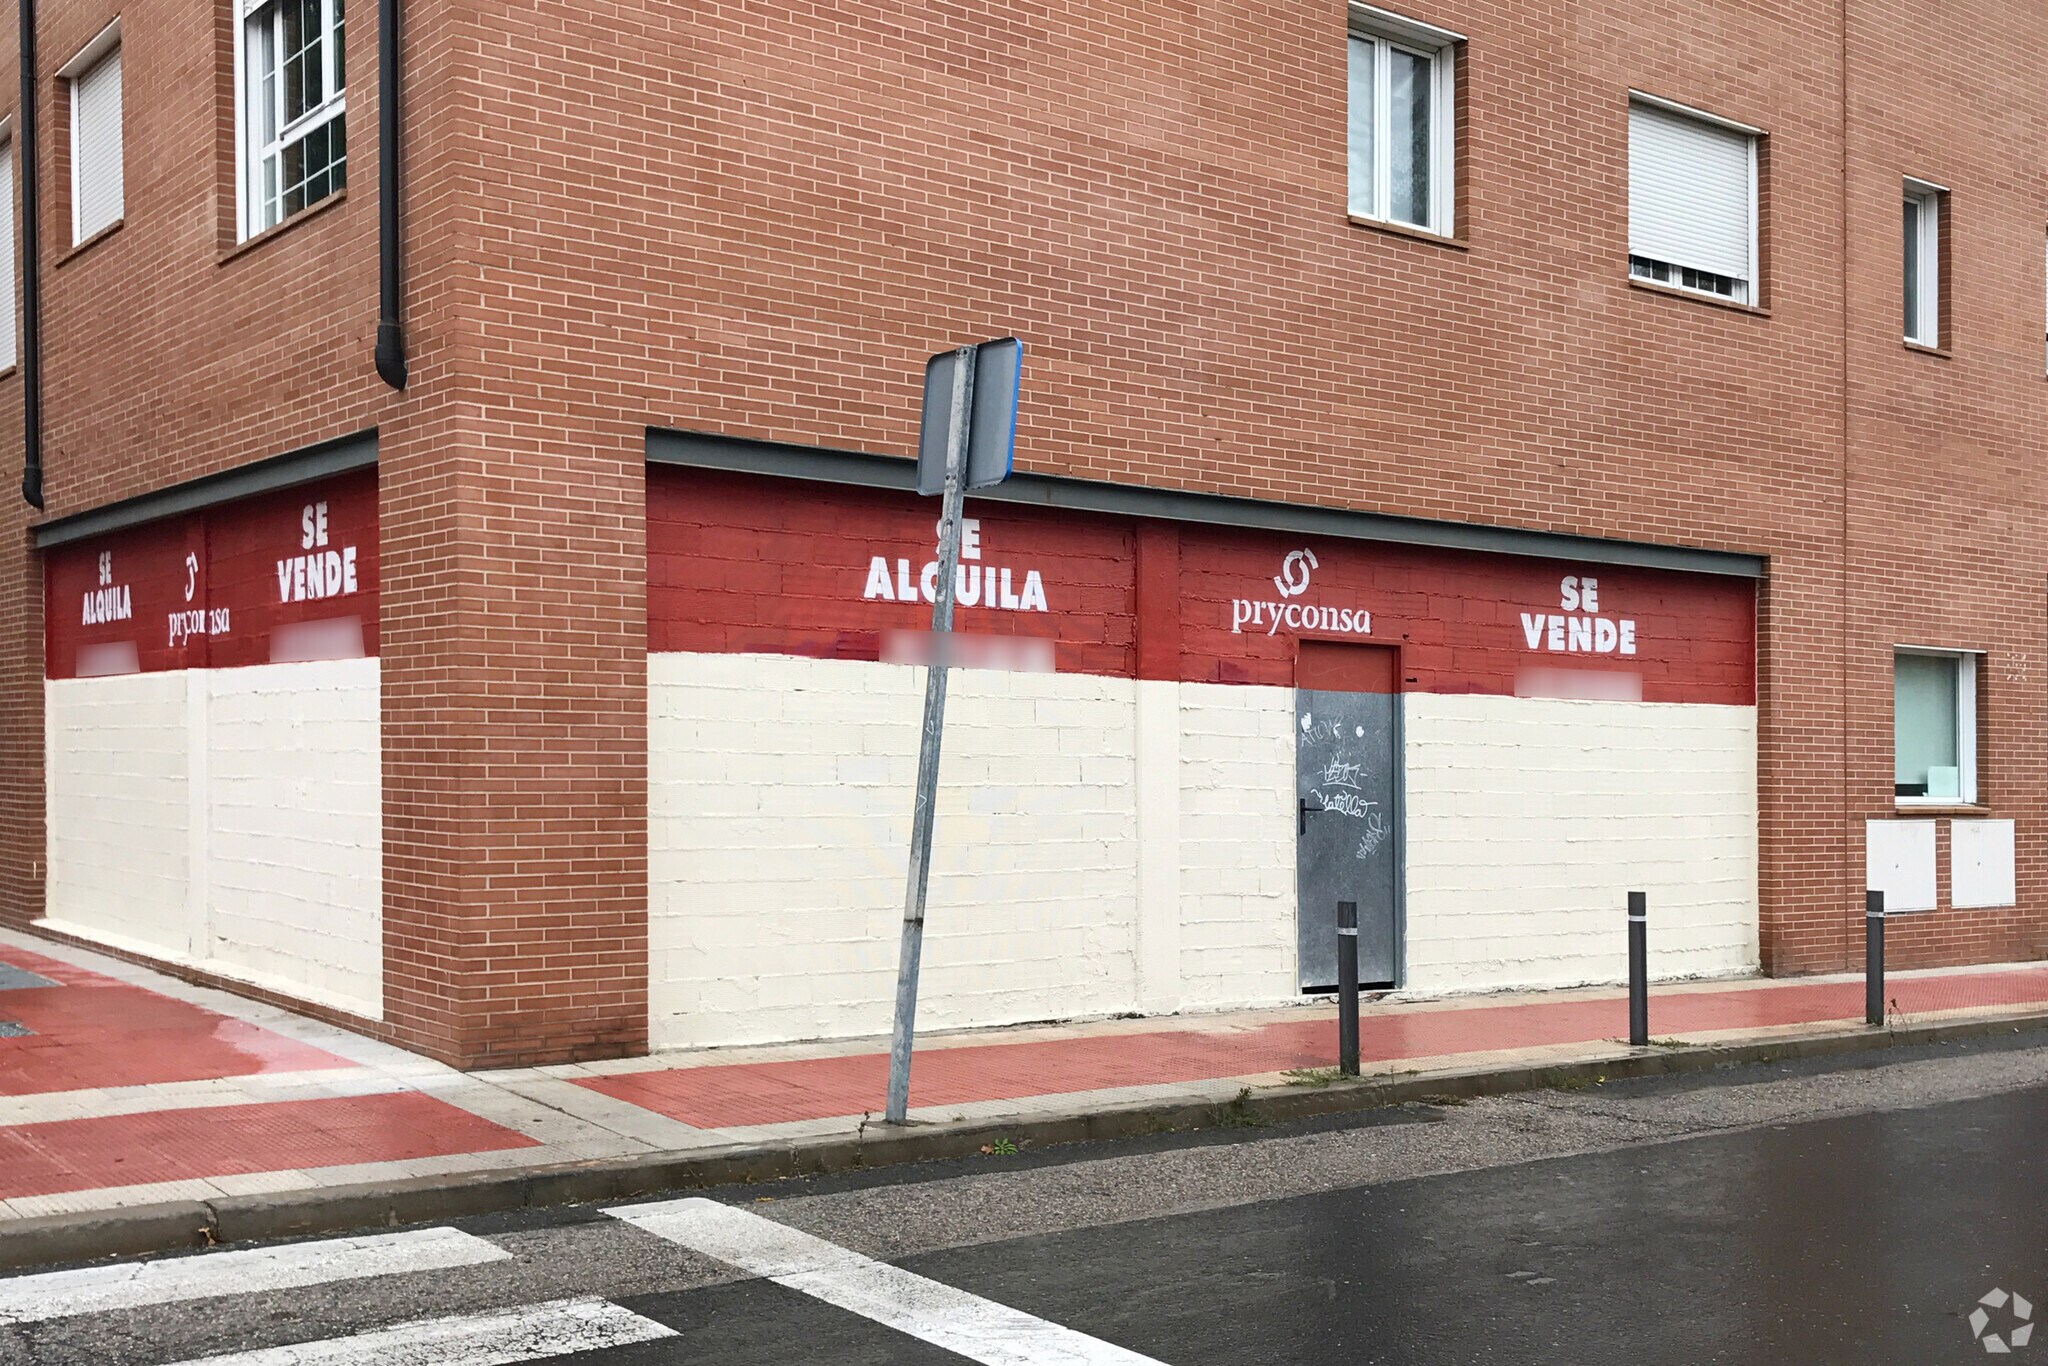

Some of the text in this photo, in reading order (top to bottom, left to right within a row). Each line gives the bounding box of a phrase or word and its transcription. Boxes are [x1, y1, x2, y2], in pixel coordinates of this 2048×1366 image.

[302, 500, 329, 550] SE
[936, 518, 981, 560] E
[99, 551, 112, 586] SE
[277, 546, 358, 604] VENDE
[82, 584, 132, 626] ALQUILA
[1560, 575, 1600, 613] SE
[1231, 599, 1371, 637] pryconsa
[1520, 613, 1636, 655] VENDE
